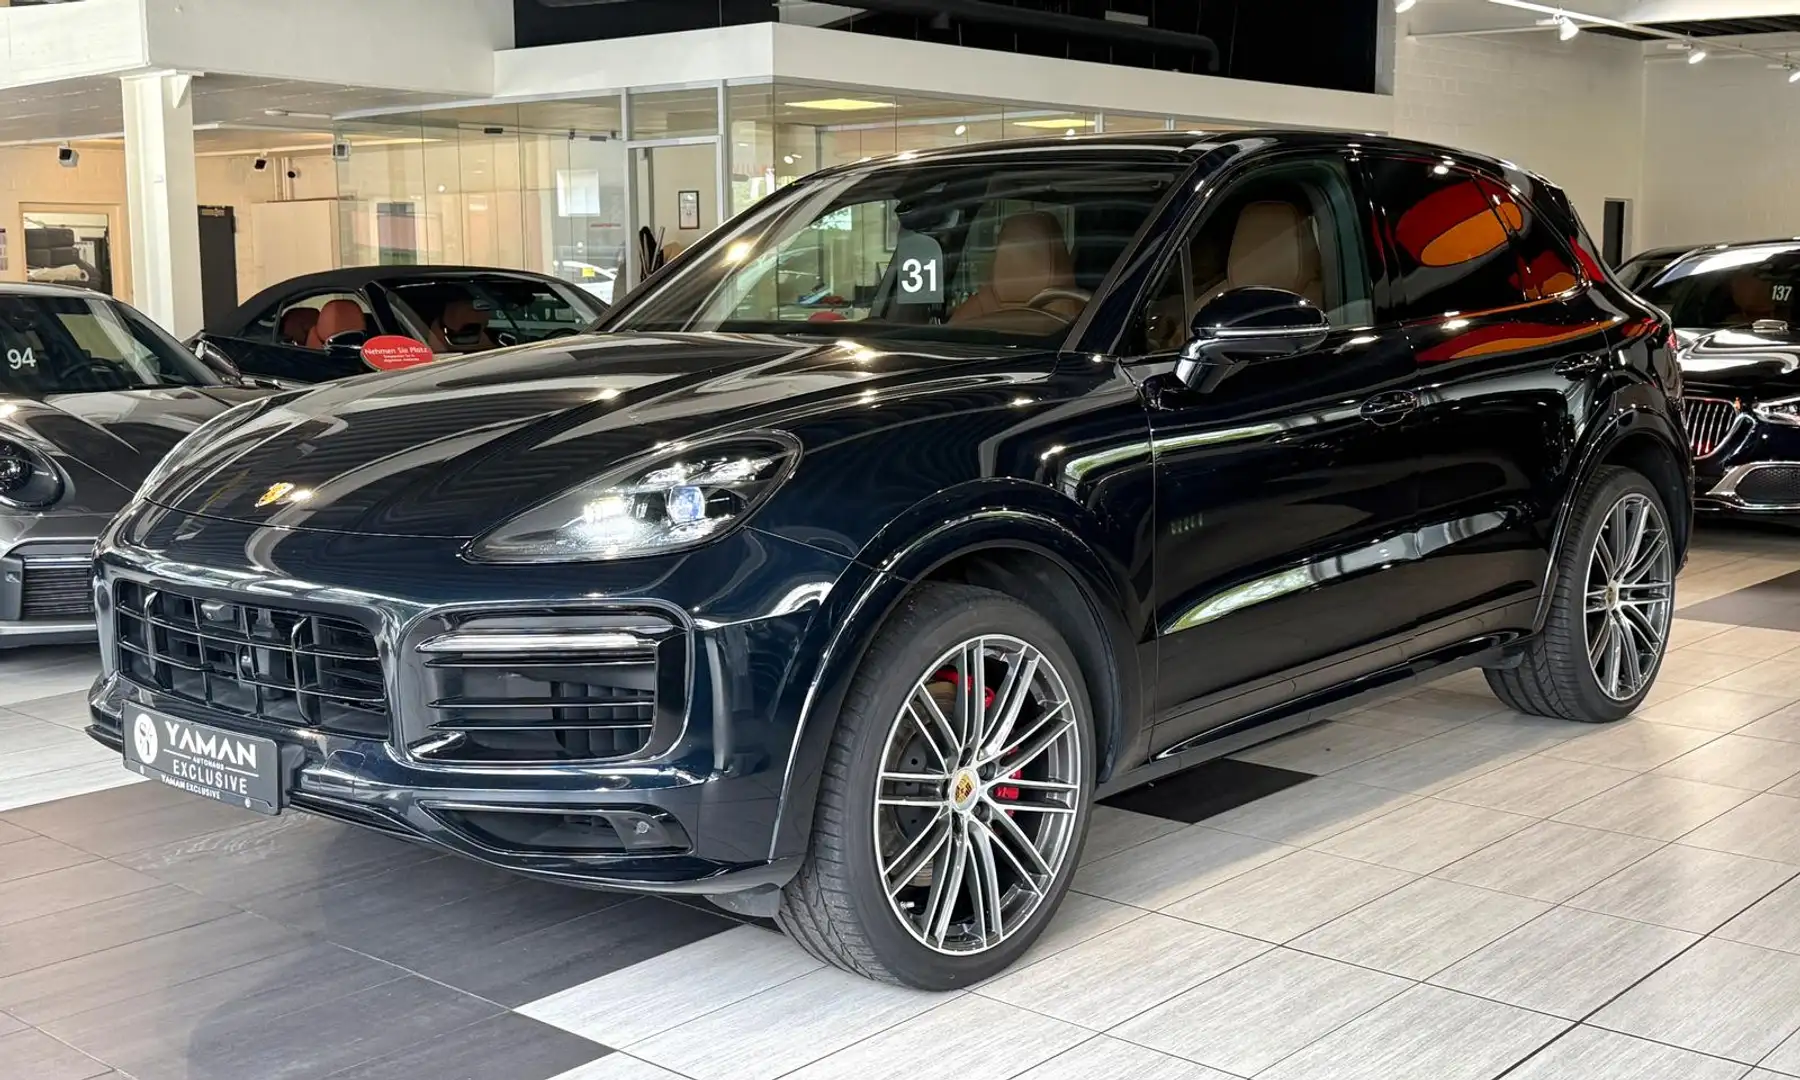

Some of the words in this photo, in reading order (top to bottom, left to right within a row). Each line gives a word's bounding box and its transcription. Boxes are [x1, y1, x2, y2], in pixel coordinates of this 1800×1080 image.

[901, 258, 936, 293] 31
[1771, 285, 1793, 301] 137
[7, 347, 37, 370] 94
[164, 721, 257, 770] YAMAN
[192, 756, 225, 771] AUTOHAUS
[161, 773, 186, 789] YAMAN
[186, 782, 221, 800] EXCLUSIVE
[172, 759, 248, 796] EXCLUSIVE
